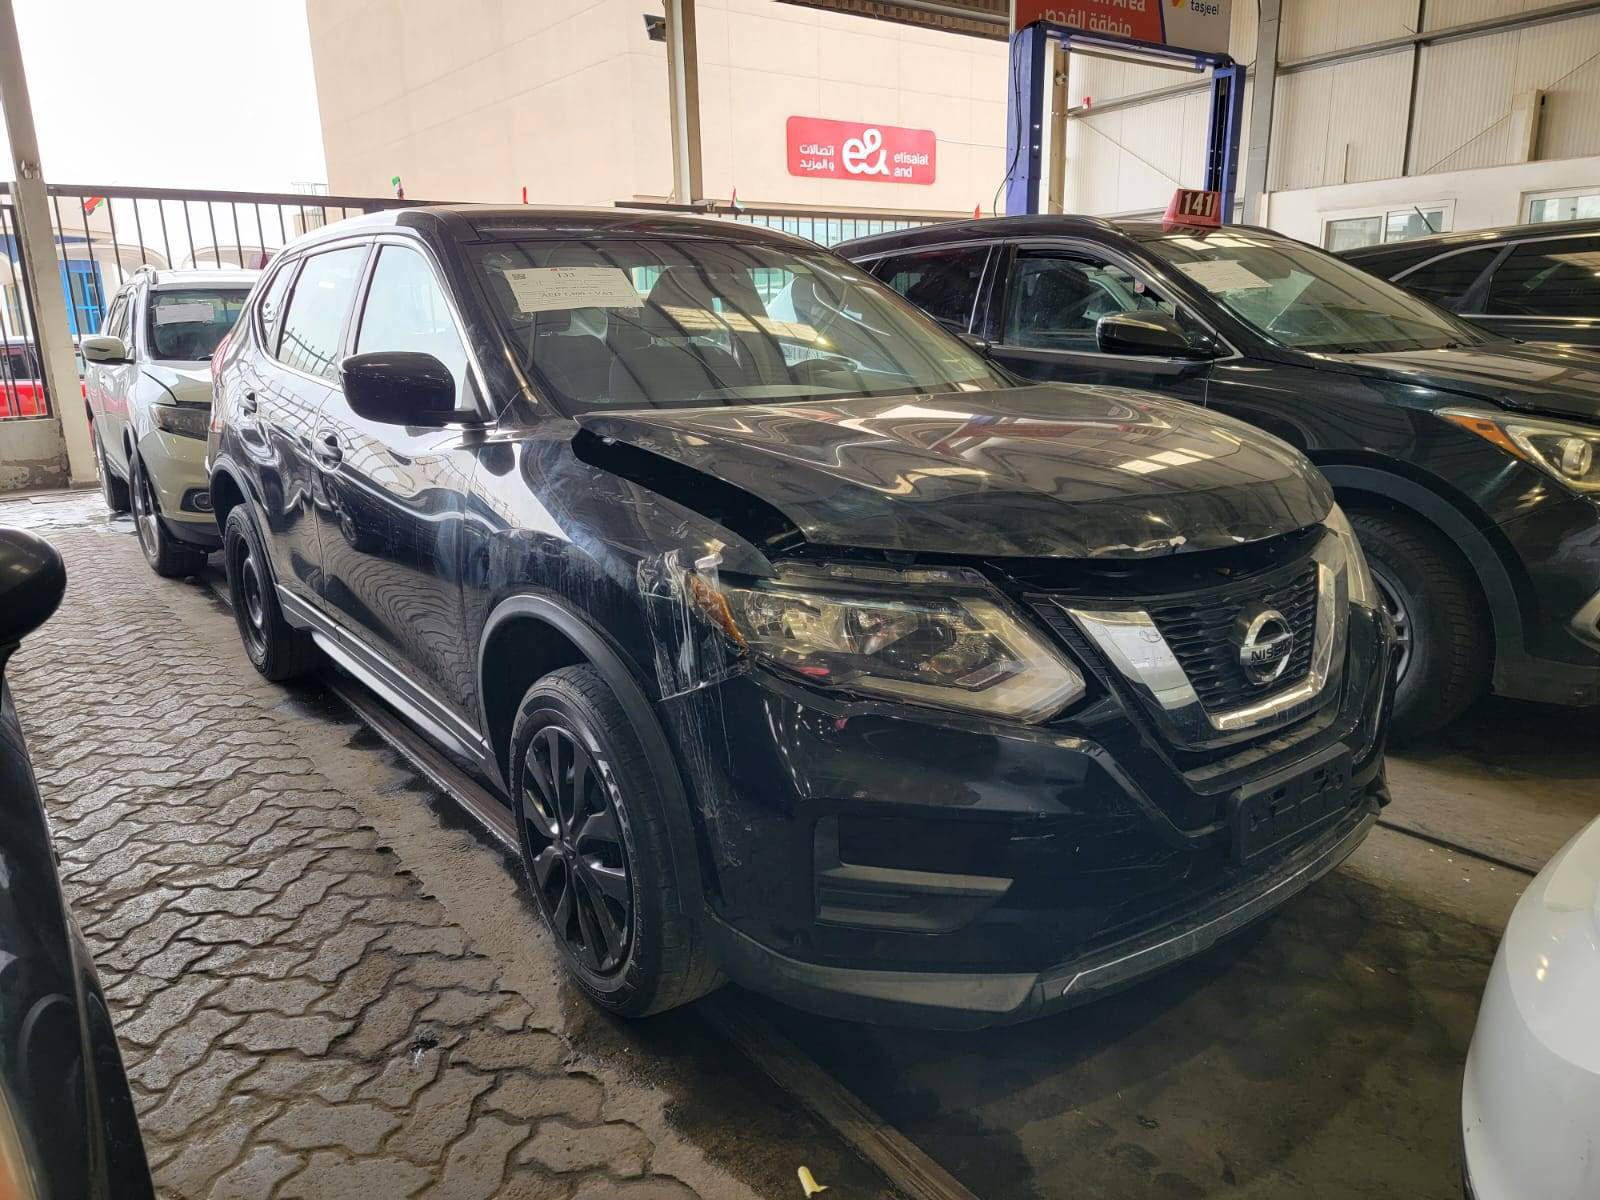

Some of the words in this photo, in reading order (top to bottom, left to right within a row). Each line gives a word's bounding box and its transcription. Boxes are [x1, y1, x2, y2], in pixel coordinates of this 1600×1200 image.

[1190, 0, 1220, 16] tasjeel
[1089, 12, 1132, 37] منطقة
[799, 143, 834, 156] اتصالات
[893, 152, 929, 166] etisalat
[893, 166, 913, 178] and
[1184, 191, 1213, 216] 141
